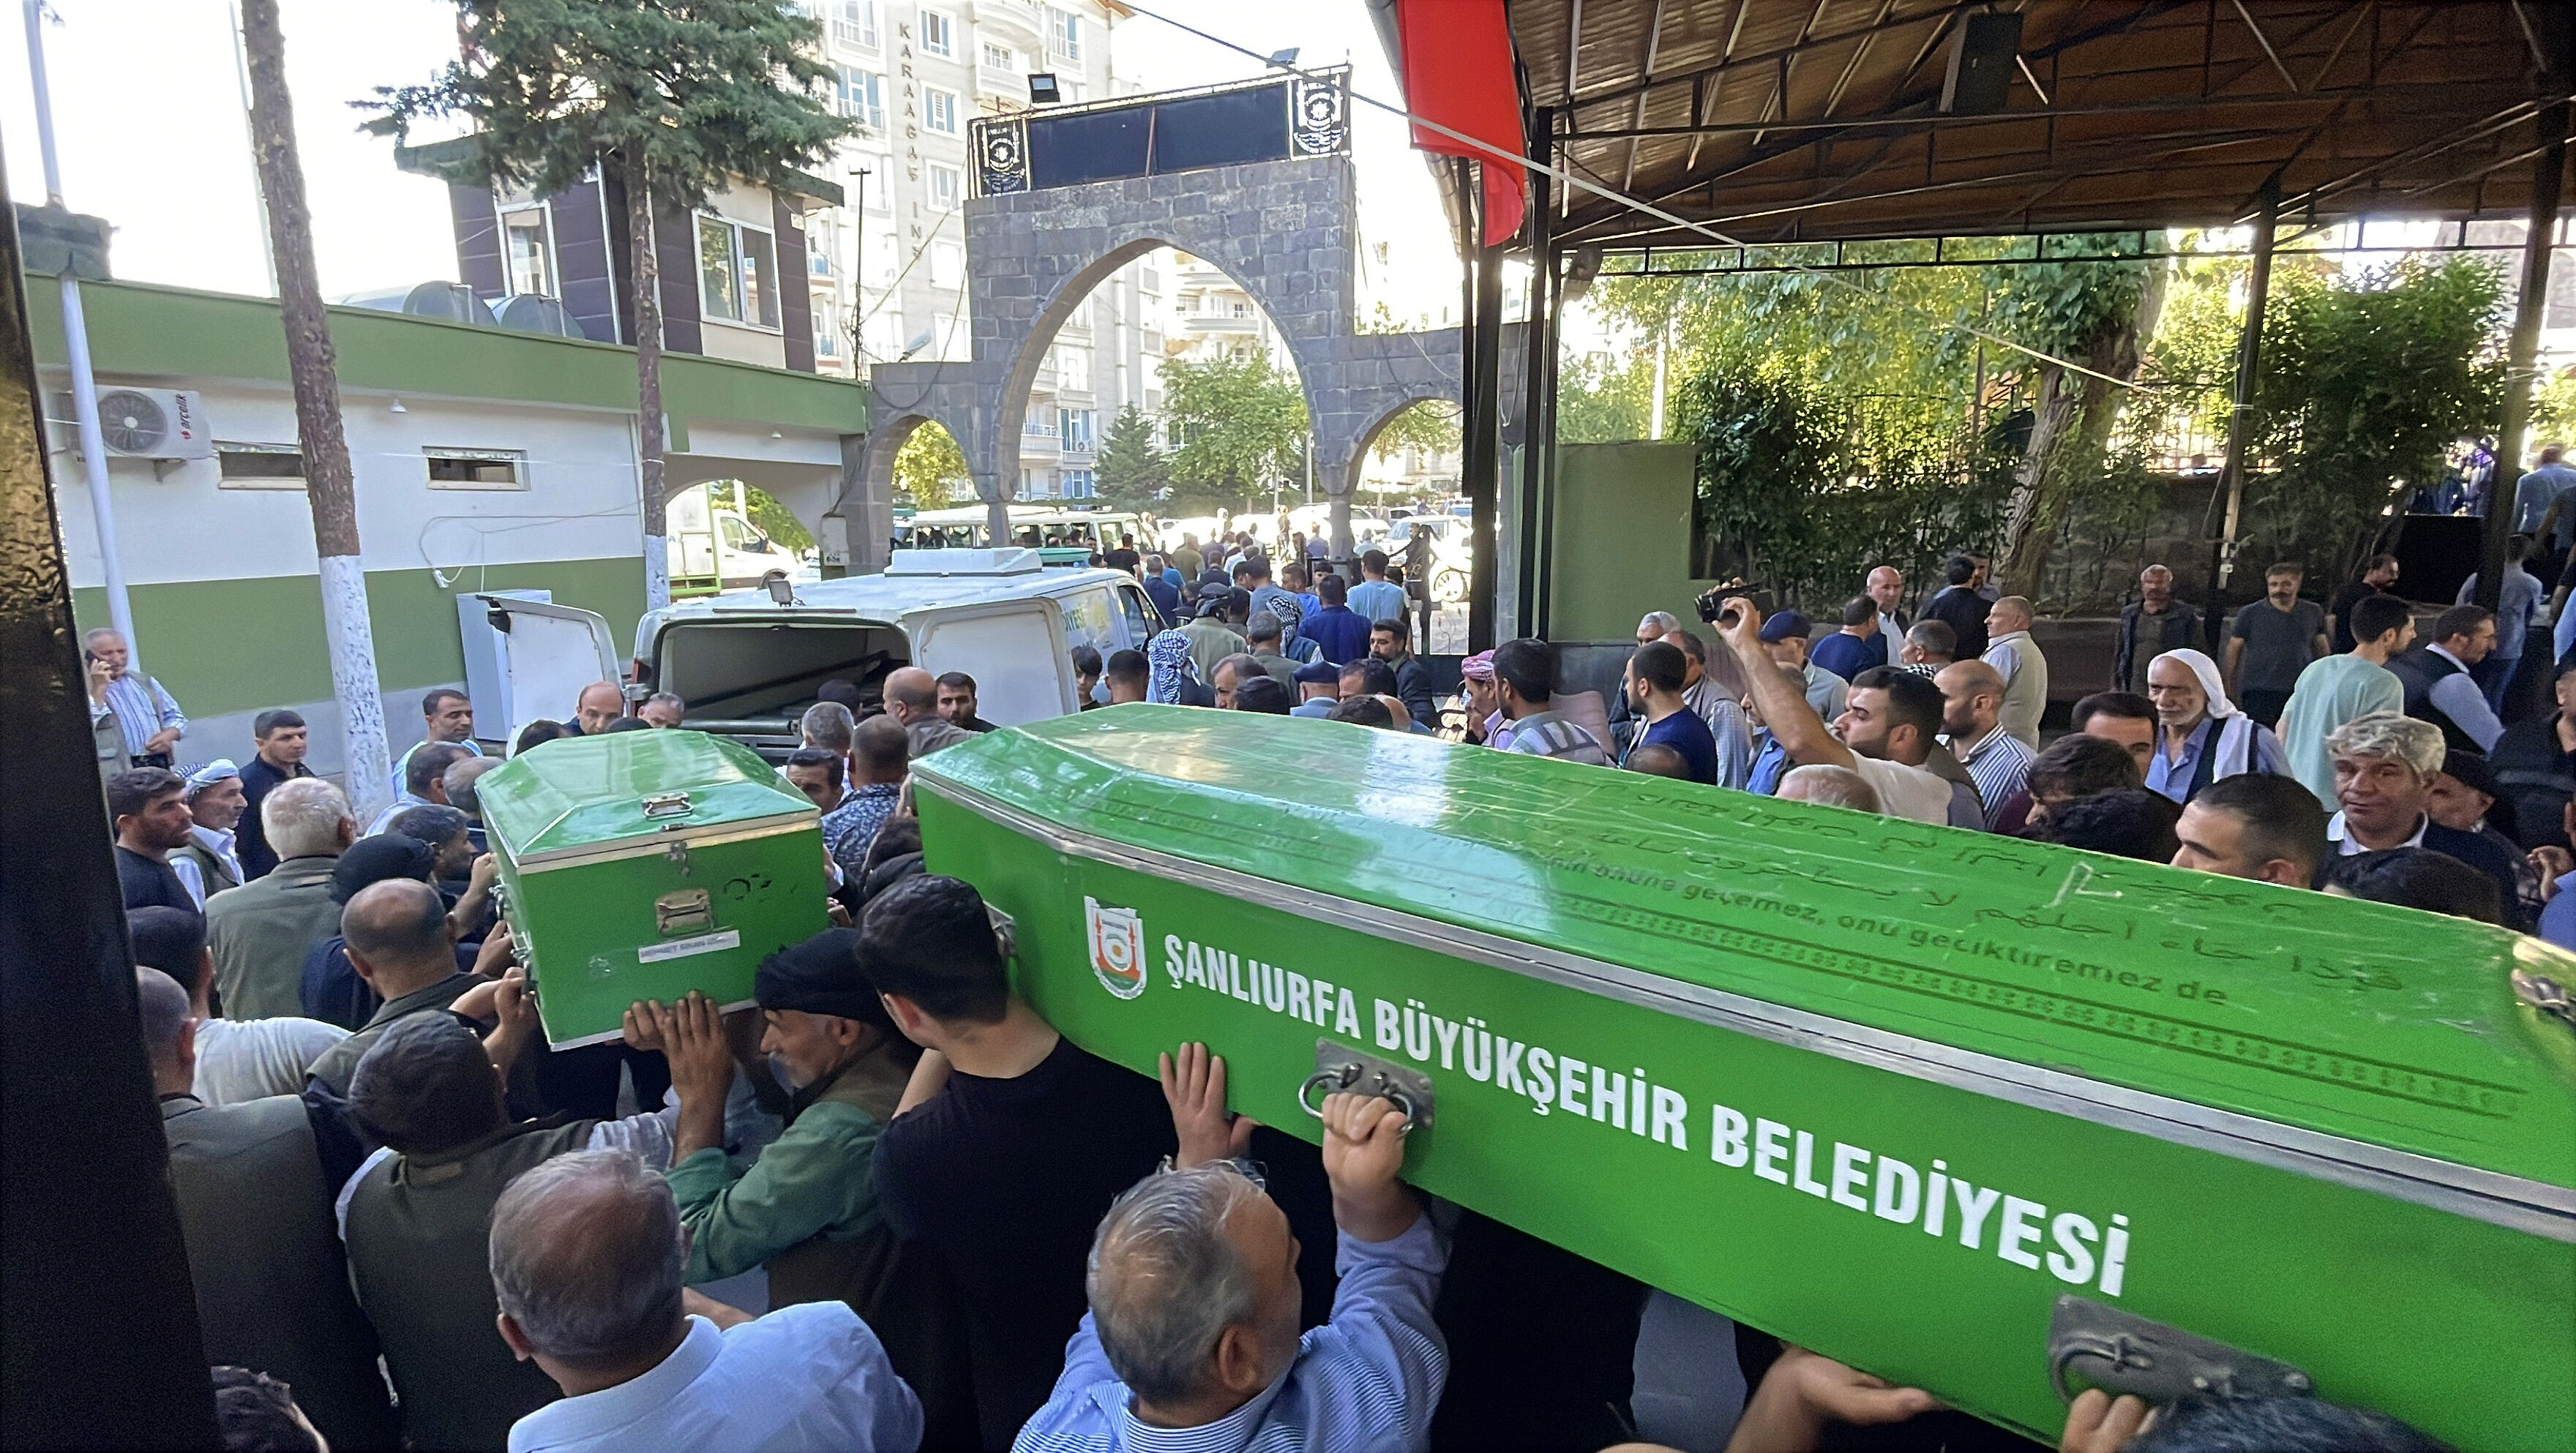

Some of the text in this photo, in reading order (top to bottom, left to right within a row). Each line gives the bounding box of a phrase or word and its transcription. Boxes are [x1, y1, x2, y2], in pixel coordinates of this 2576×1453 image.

[2177, 980, 2228, 1006] de
[1164, 934, 2130, 1298] ŞANLIURFA BÜYÜKŞEHİR BELEDİYESİ
